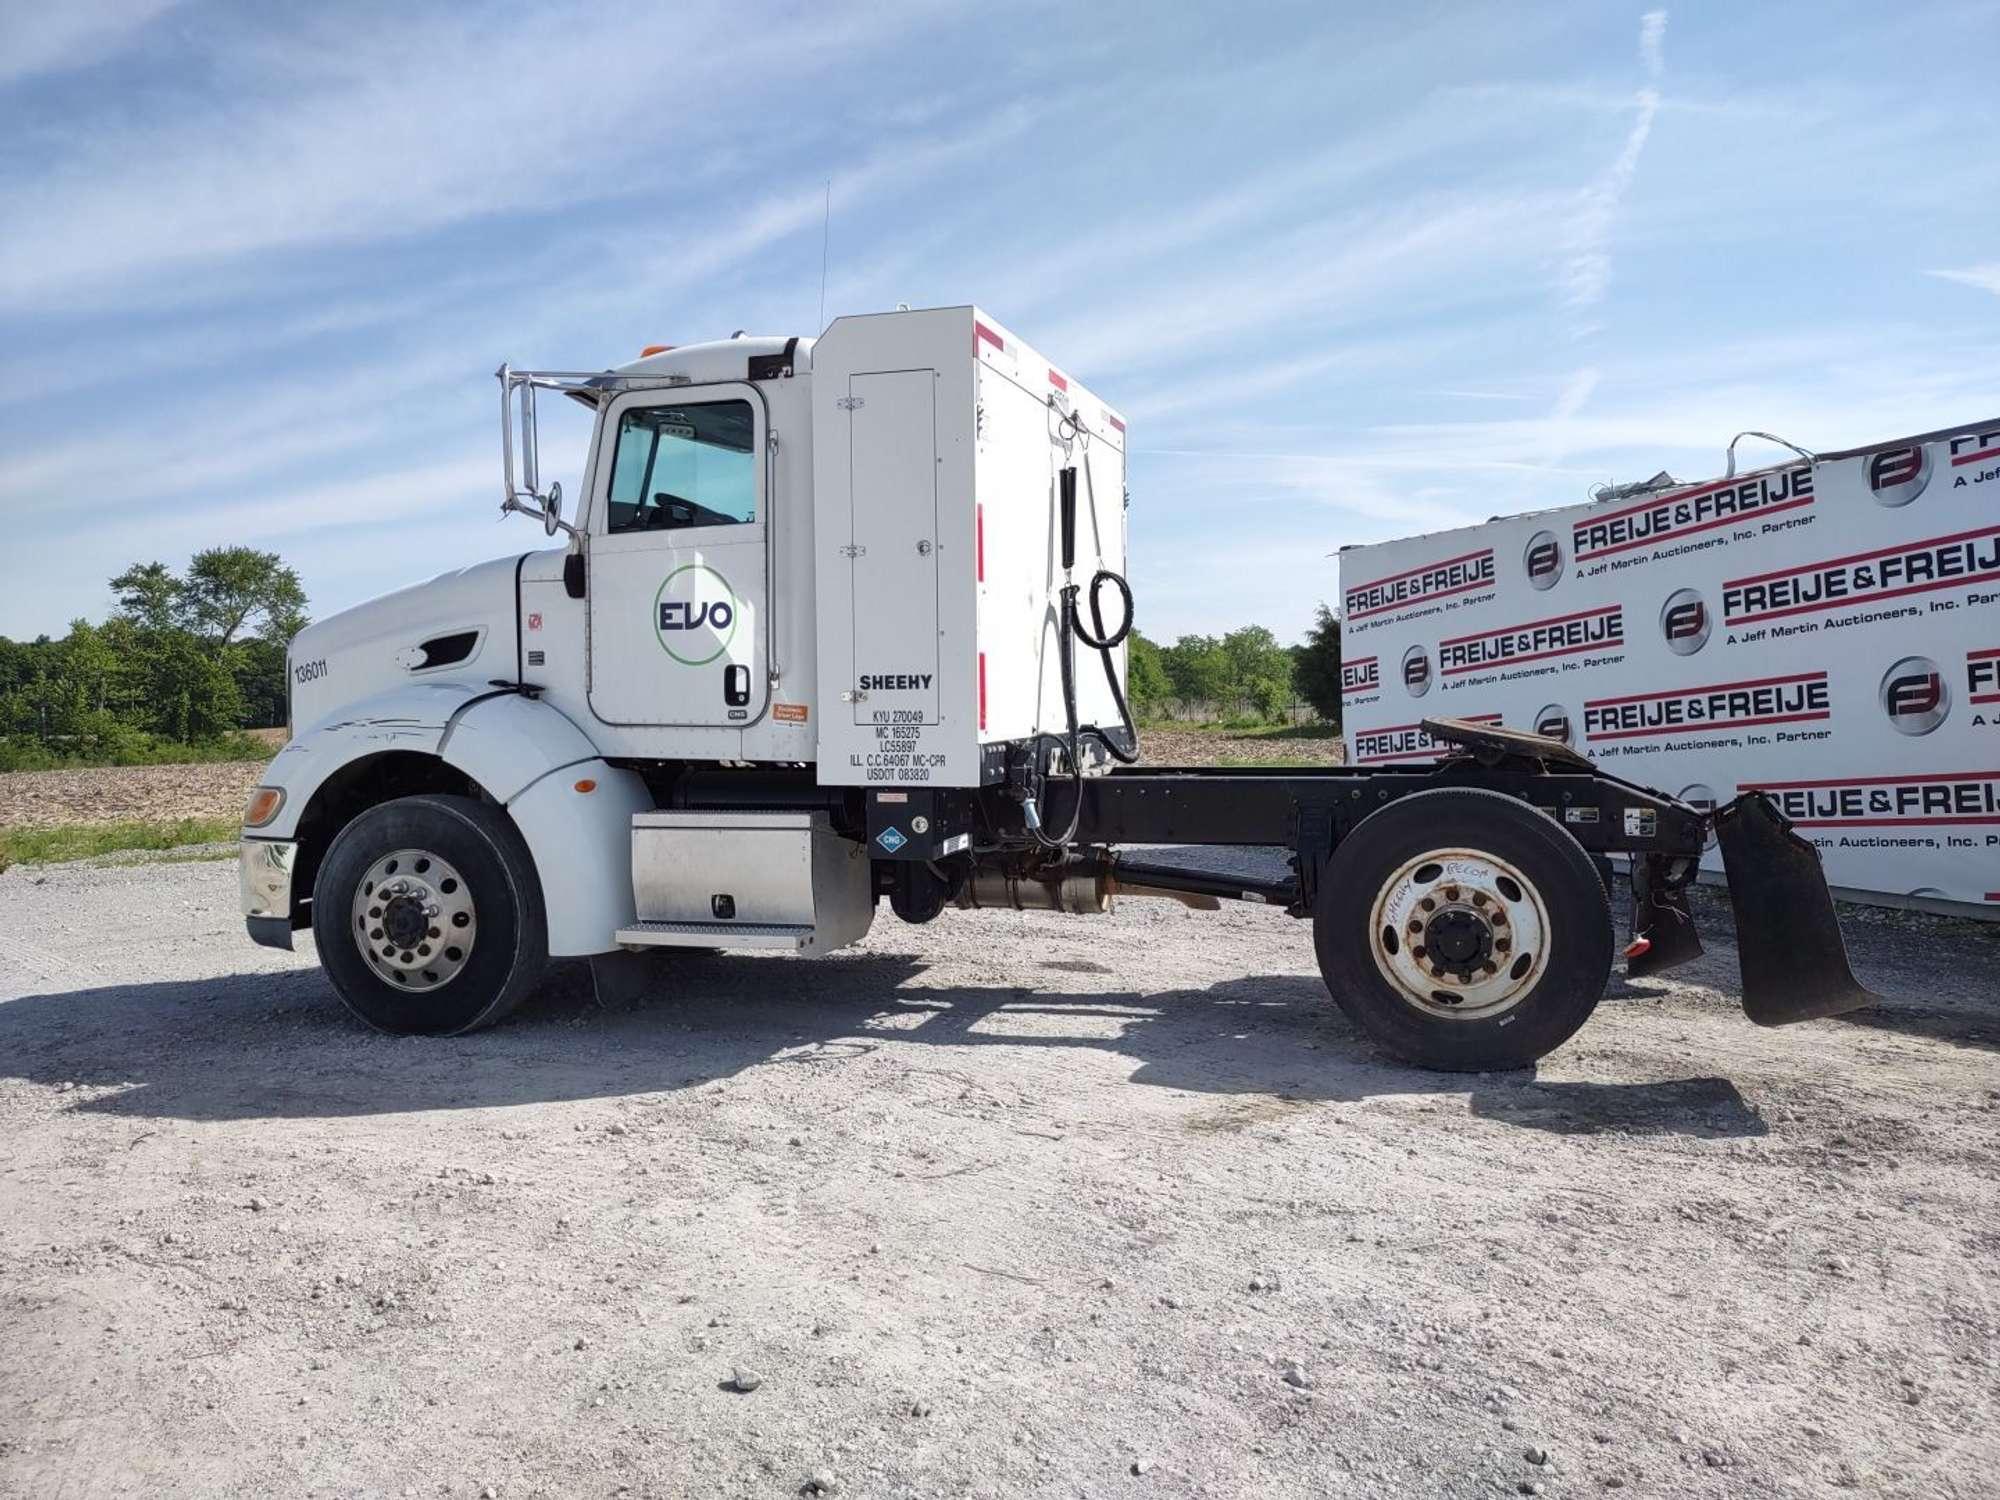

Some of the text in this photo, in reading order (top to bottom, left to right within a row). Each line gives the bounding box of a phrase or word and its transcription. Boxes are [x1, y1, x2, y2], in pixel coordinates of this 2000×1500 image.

[1953, 476, 1967, 488] A
[1576, 516, 1816, 579] A Jeff Martin Auctioneers, Inc. Partner
[660, 602, 732, 630] EVO
[1726, 635, 1738, 646] A
[1741, 629, 1766, 643] Jeff
[1771, 622, 1819, 638] Martin
[1823, 606, 1923, 630] Auctioneers,
[1930, 600, 1960, 612] Inc.
[295, 660, 327, 685] 136011
[1441, 682, 1449, 691] A
[1451, 678, 1466, 690] Jeff
[1468, 672, 1497, 687] Martin
[1562, 661, 1580, 671] Inc.
[1584, 654, 1625, 668] Partner
[860, 674, 932, 690] SHEEHY
[873, 710, 923, 723] KYU 270049
[1972, 715, 1986, 726] A
[876, 727, 921, 739] MC 165275
[1587, 731, 1832, 758] A Jeff Martin Auctioneers, Inc. Partner
[912, 754, 946, 767] MC-CPR
[866, 768, 896, 781] USDOT
[1839, 836, 1940, 850] Auctioneers,
[1947, 835, 1978, 847] Inc.
